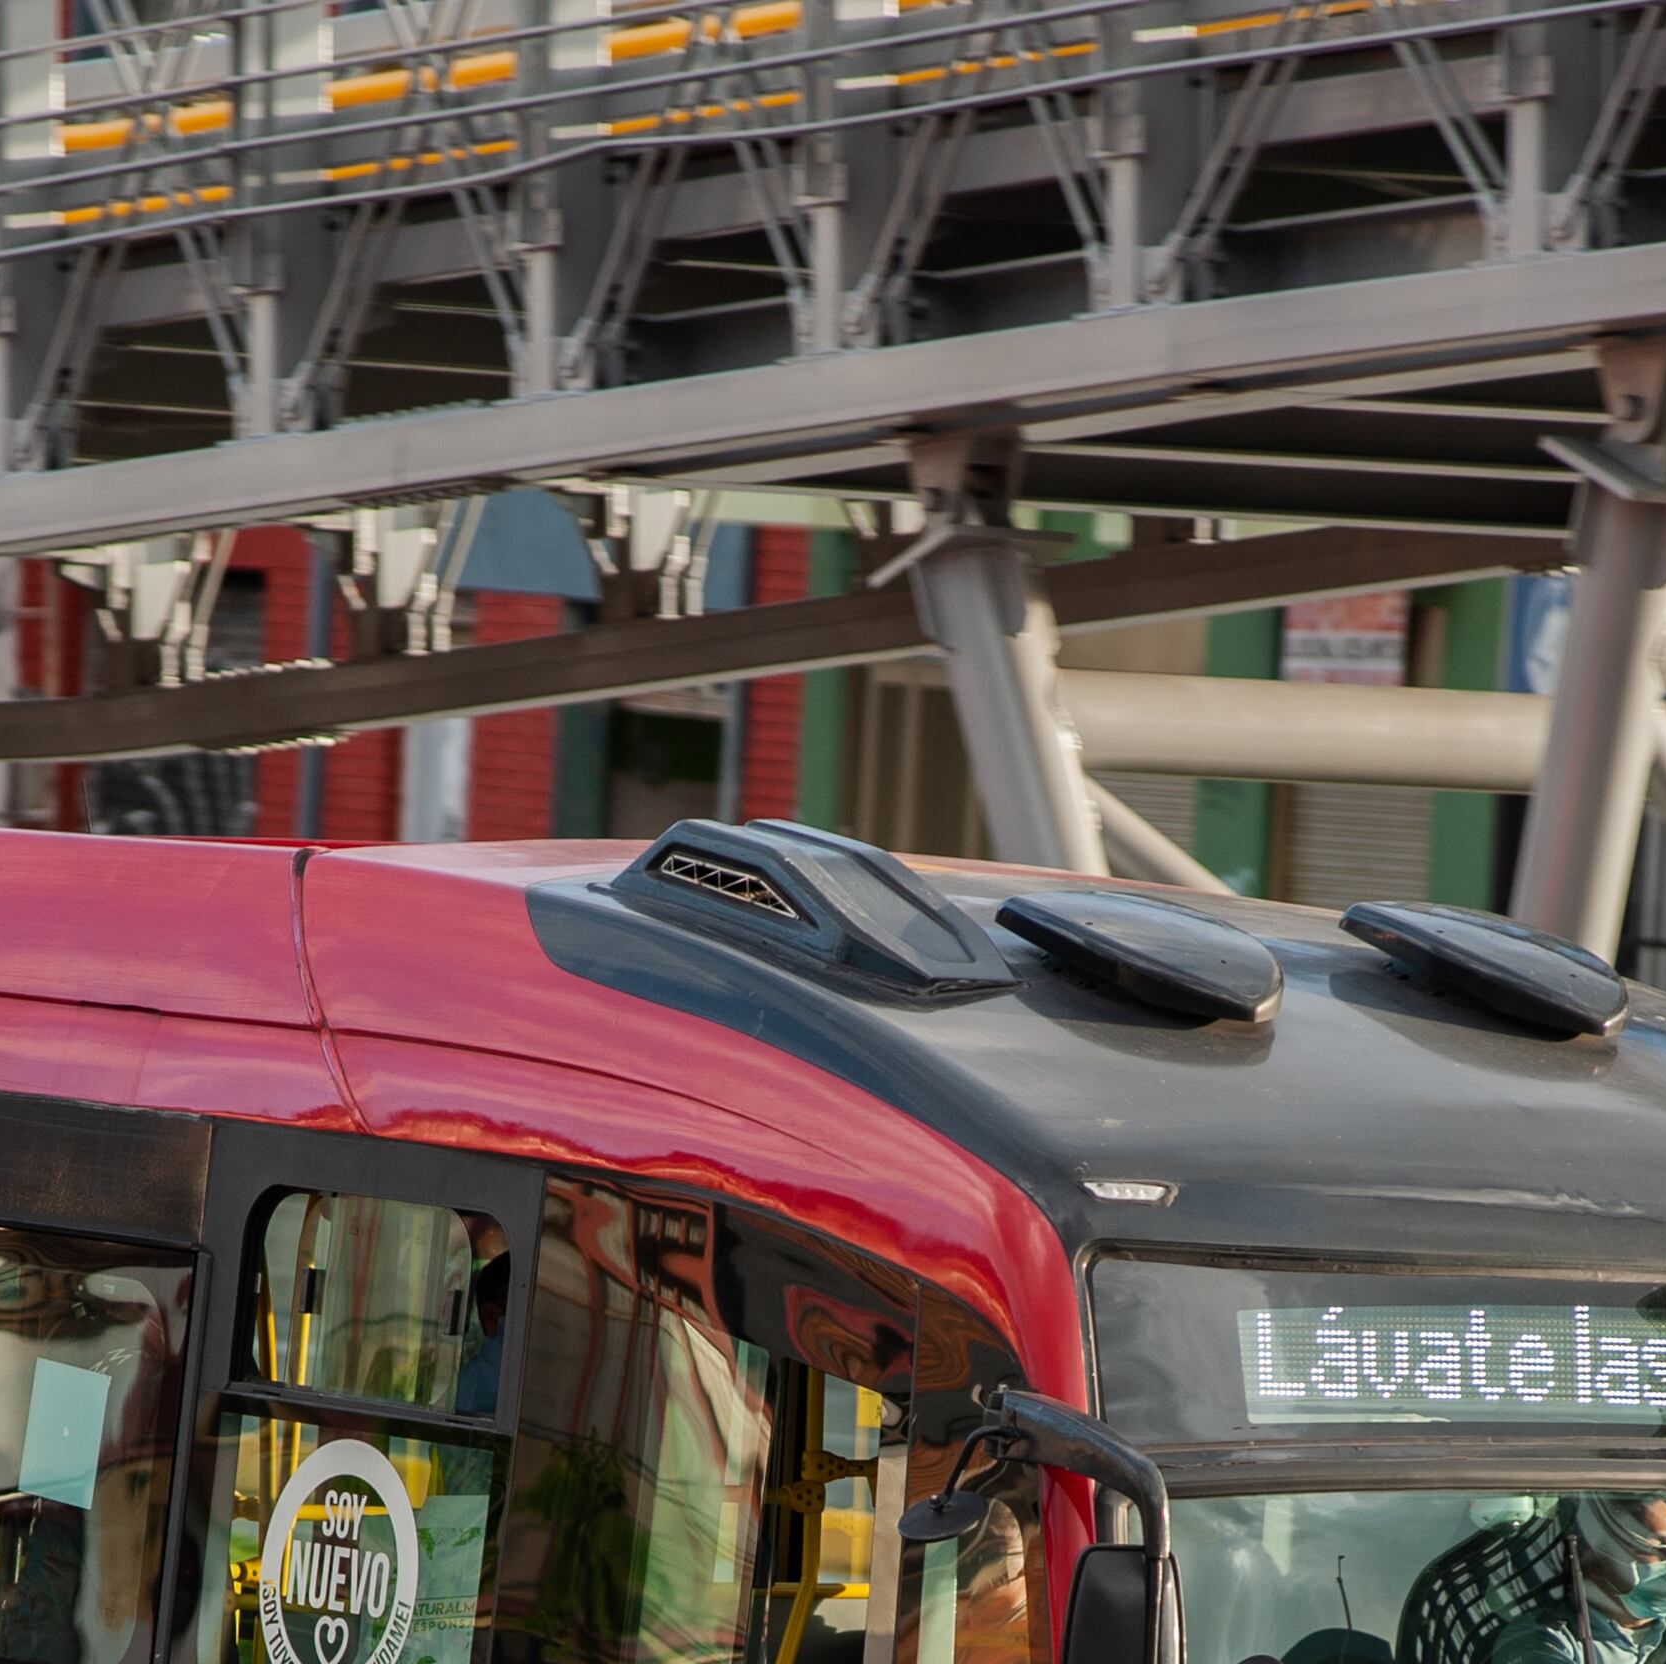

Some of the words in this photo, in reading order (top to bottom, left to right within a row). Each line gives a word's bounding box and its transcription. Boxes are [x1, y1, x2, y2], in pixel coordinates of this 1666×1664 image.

[1257, 1306, 1555, 1402] Lávate
[321, 1489, 368, 1539] SOY
[286, 1543, 390, 1619] NUEVO
